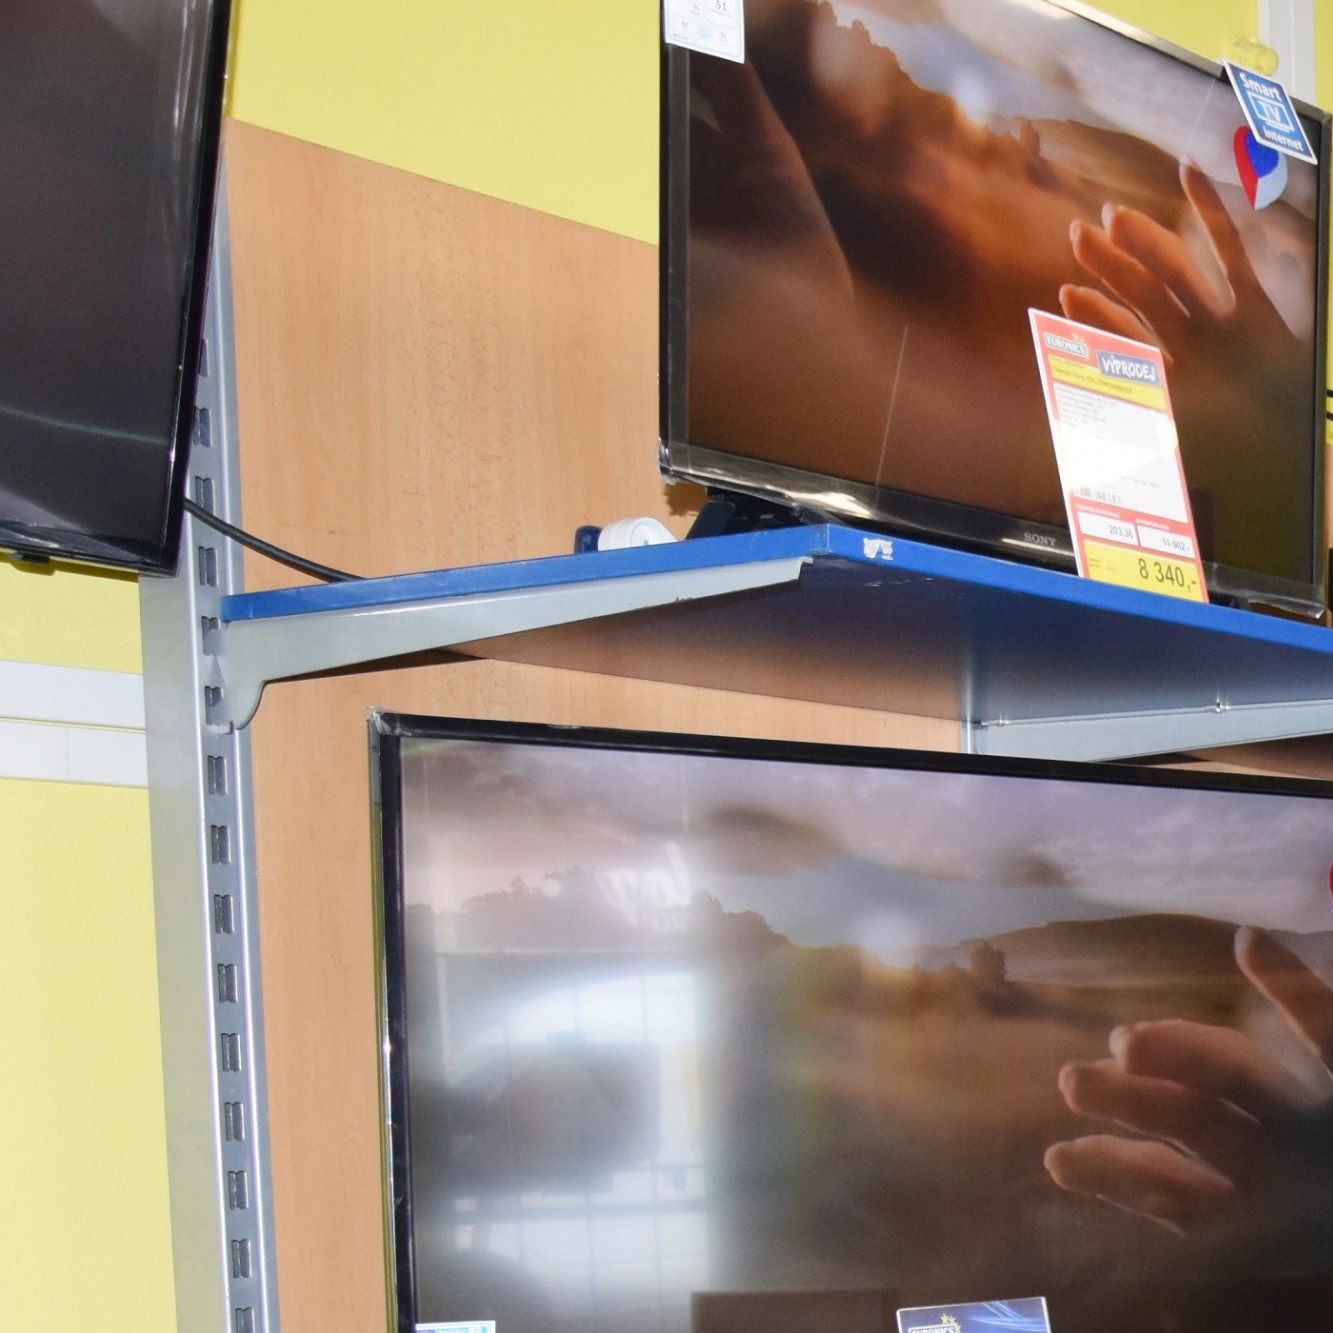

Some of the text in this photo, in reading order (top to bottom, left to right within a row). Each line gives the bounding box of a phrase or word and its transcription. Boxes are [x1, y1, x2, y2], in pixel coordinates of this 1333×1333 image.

[1239, 72, 1282, 102] Smart
[1263, 126, 1304, 152] internet
[1102, 355, 1156, 382] VÝPRODEJ
[1024, 532, 1056, 546] SONY
[1138, 558, 1197, 593] 8 340,-
